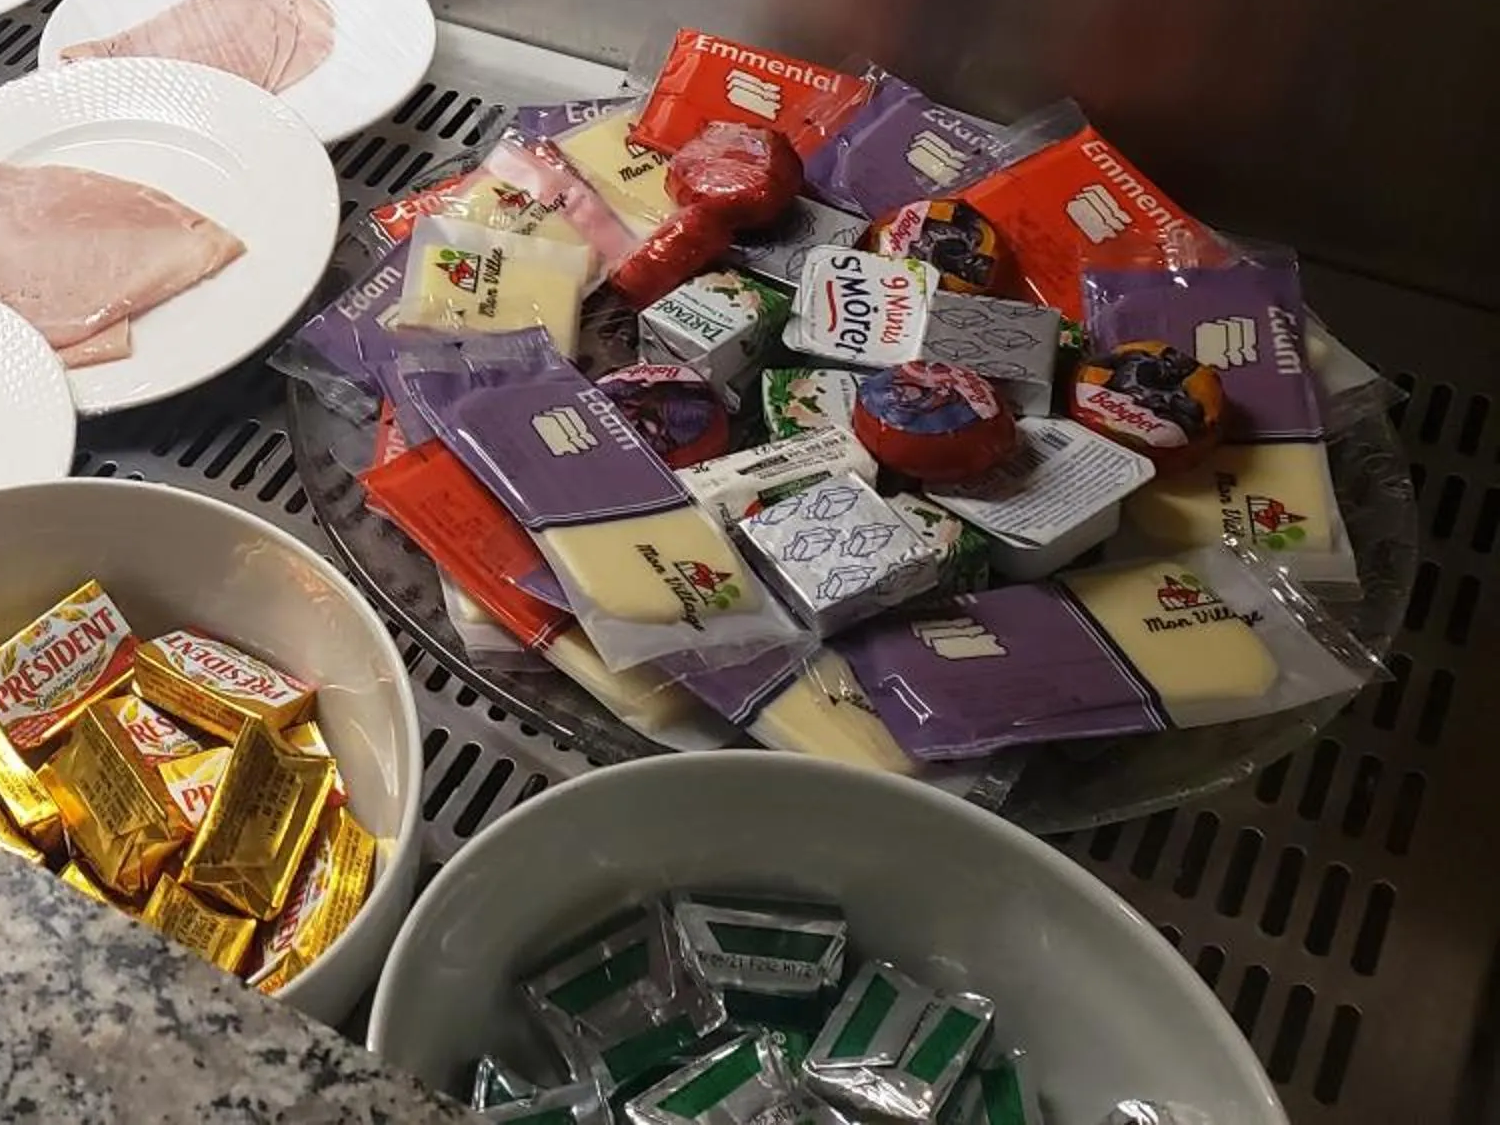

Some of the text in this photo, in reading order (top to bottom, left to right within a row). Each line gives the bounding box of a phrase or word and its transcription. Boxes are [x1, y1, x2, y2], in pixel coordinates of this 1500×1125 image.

[694, 33, 841, 94] Emmental
[565, 101, 612, 125] Ed
[888, 208, 921, 253] Babyb
[336, 265, 403, 321] Edam
[879, 275, 909, 290] 9
[576, 386, 639, 451] Edam
[1087, 391, 1163, 432] Babybel
[1142, 606, 1264, 633] Mon Village
